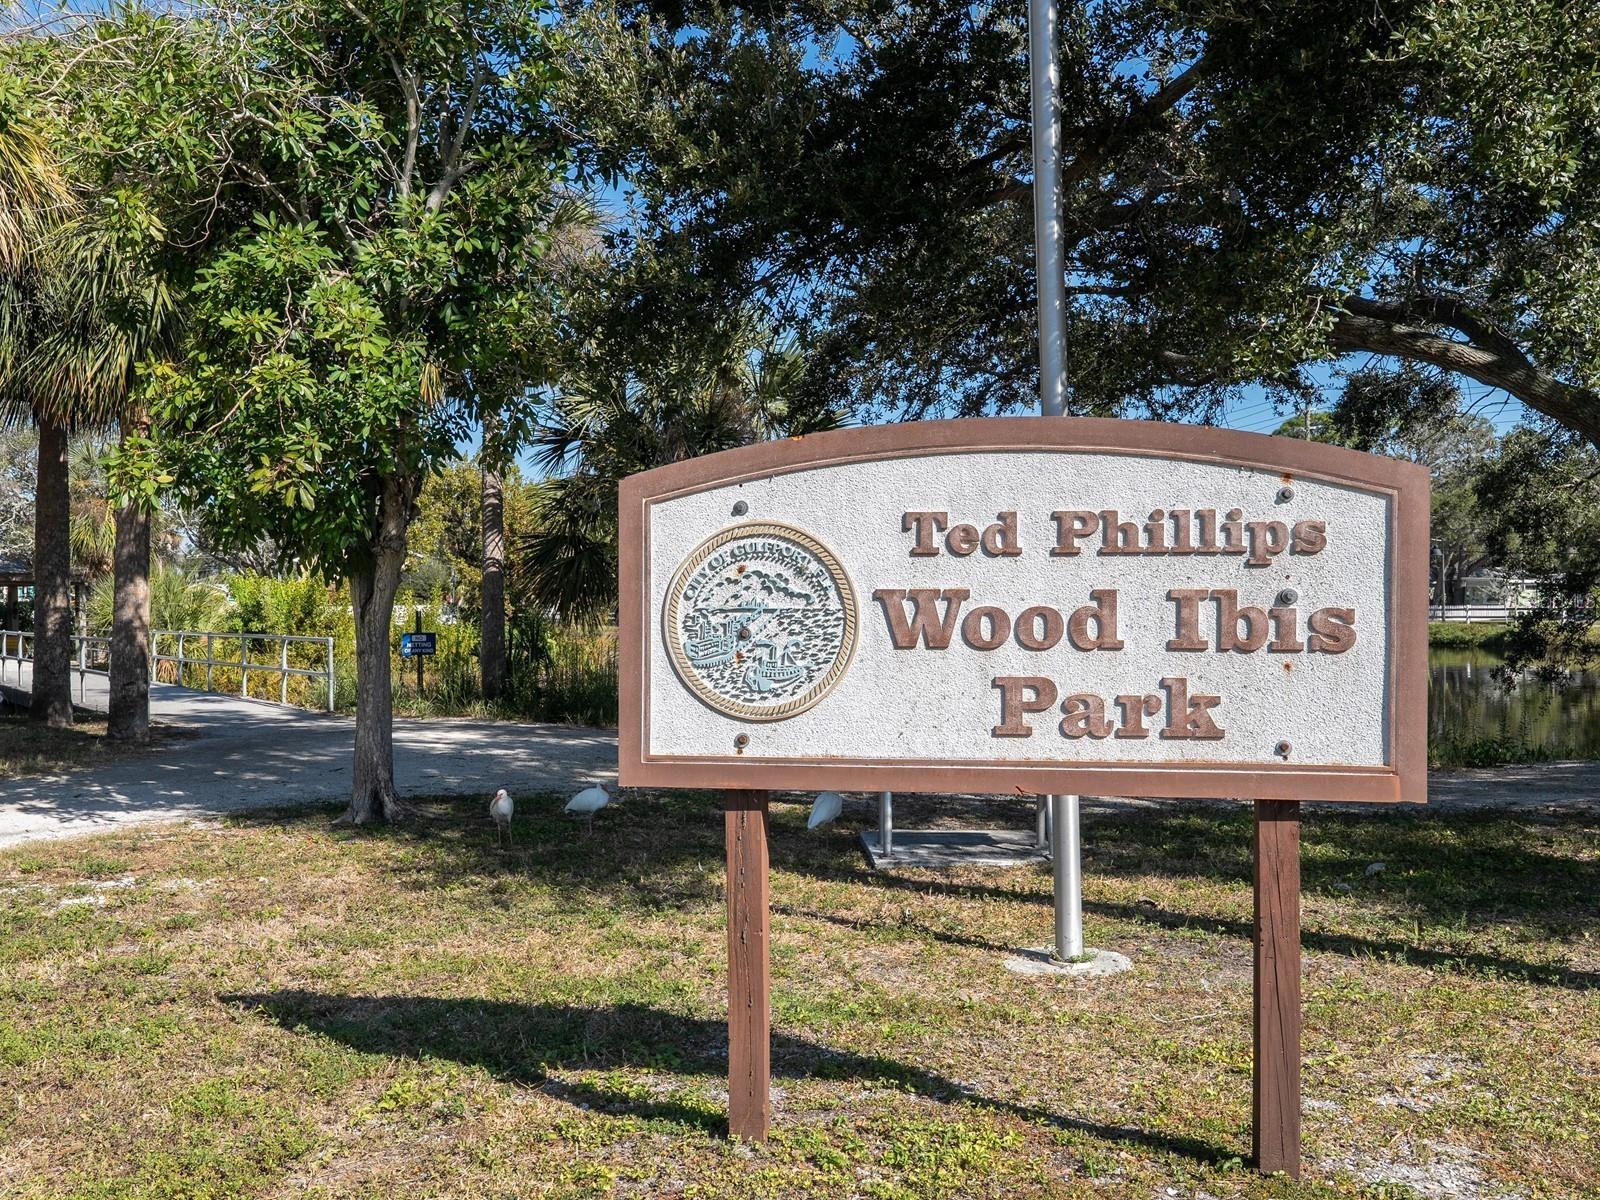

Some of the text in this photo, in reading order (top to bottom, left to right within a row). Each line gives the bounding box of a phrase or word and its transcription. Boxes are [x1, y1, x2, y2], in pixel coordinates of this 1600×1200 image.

[902, 508, 1328, 567] Ted Phillips
[683, 566, 710, 601] CITY
[708, 551, 731, 572] OF
[731, 542, 812, 565] GULFPORT
[873, 588, 1358, 654] Wood Ibis
[991, 676, 1226, 741] Park
